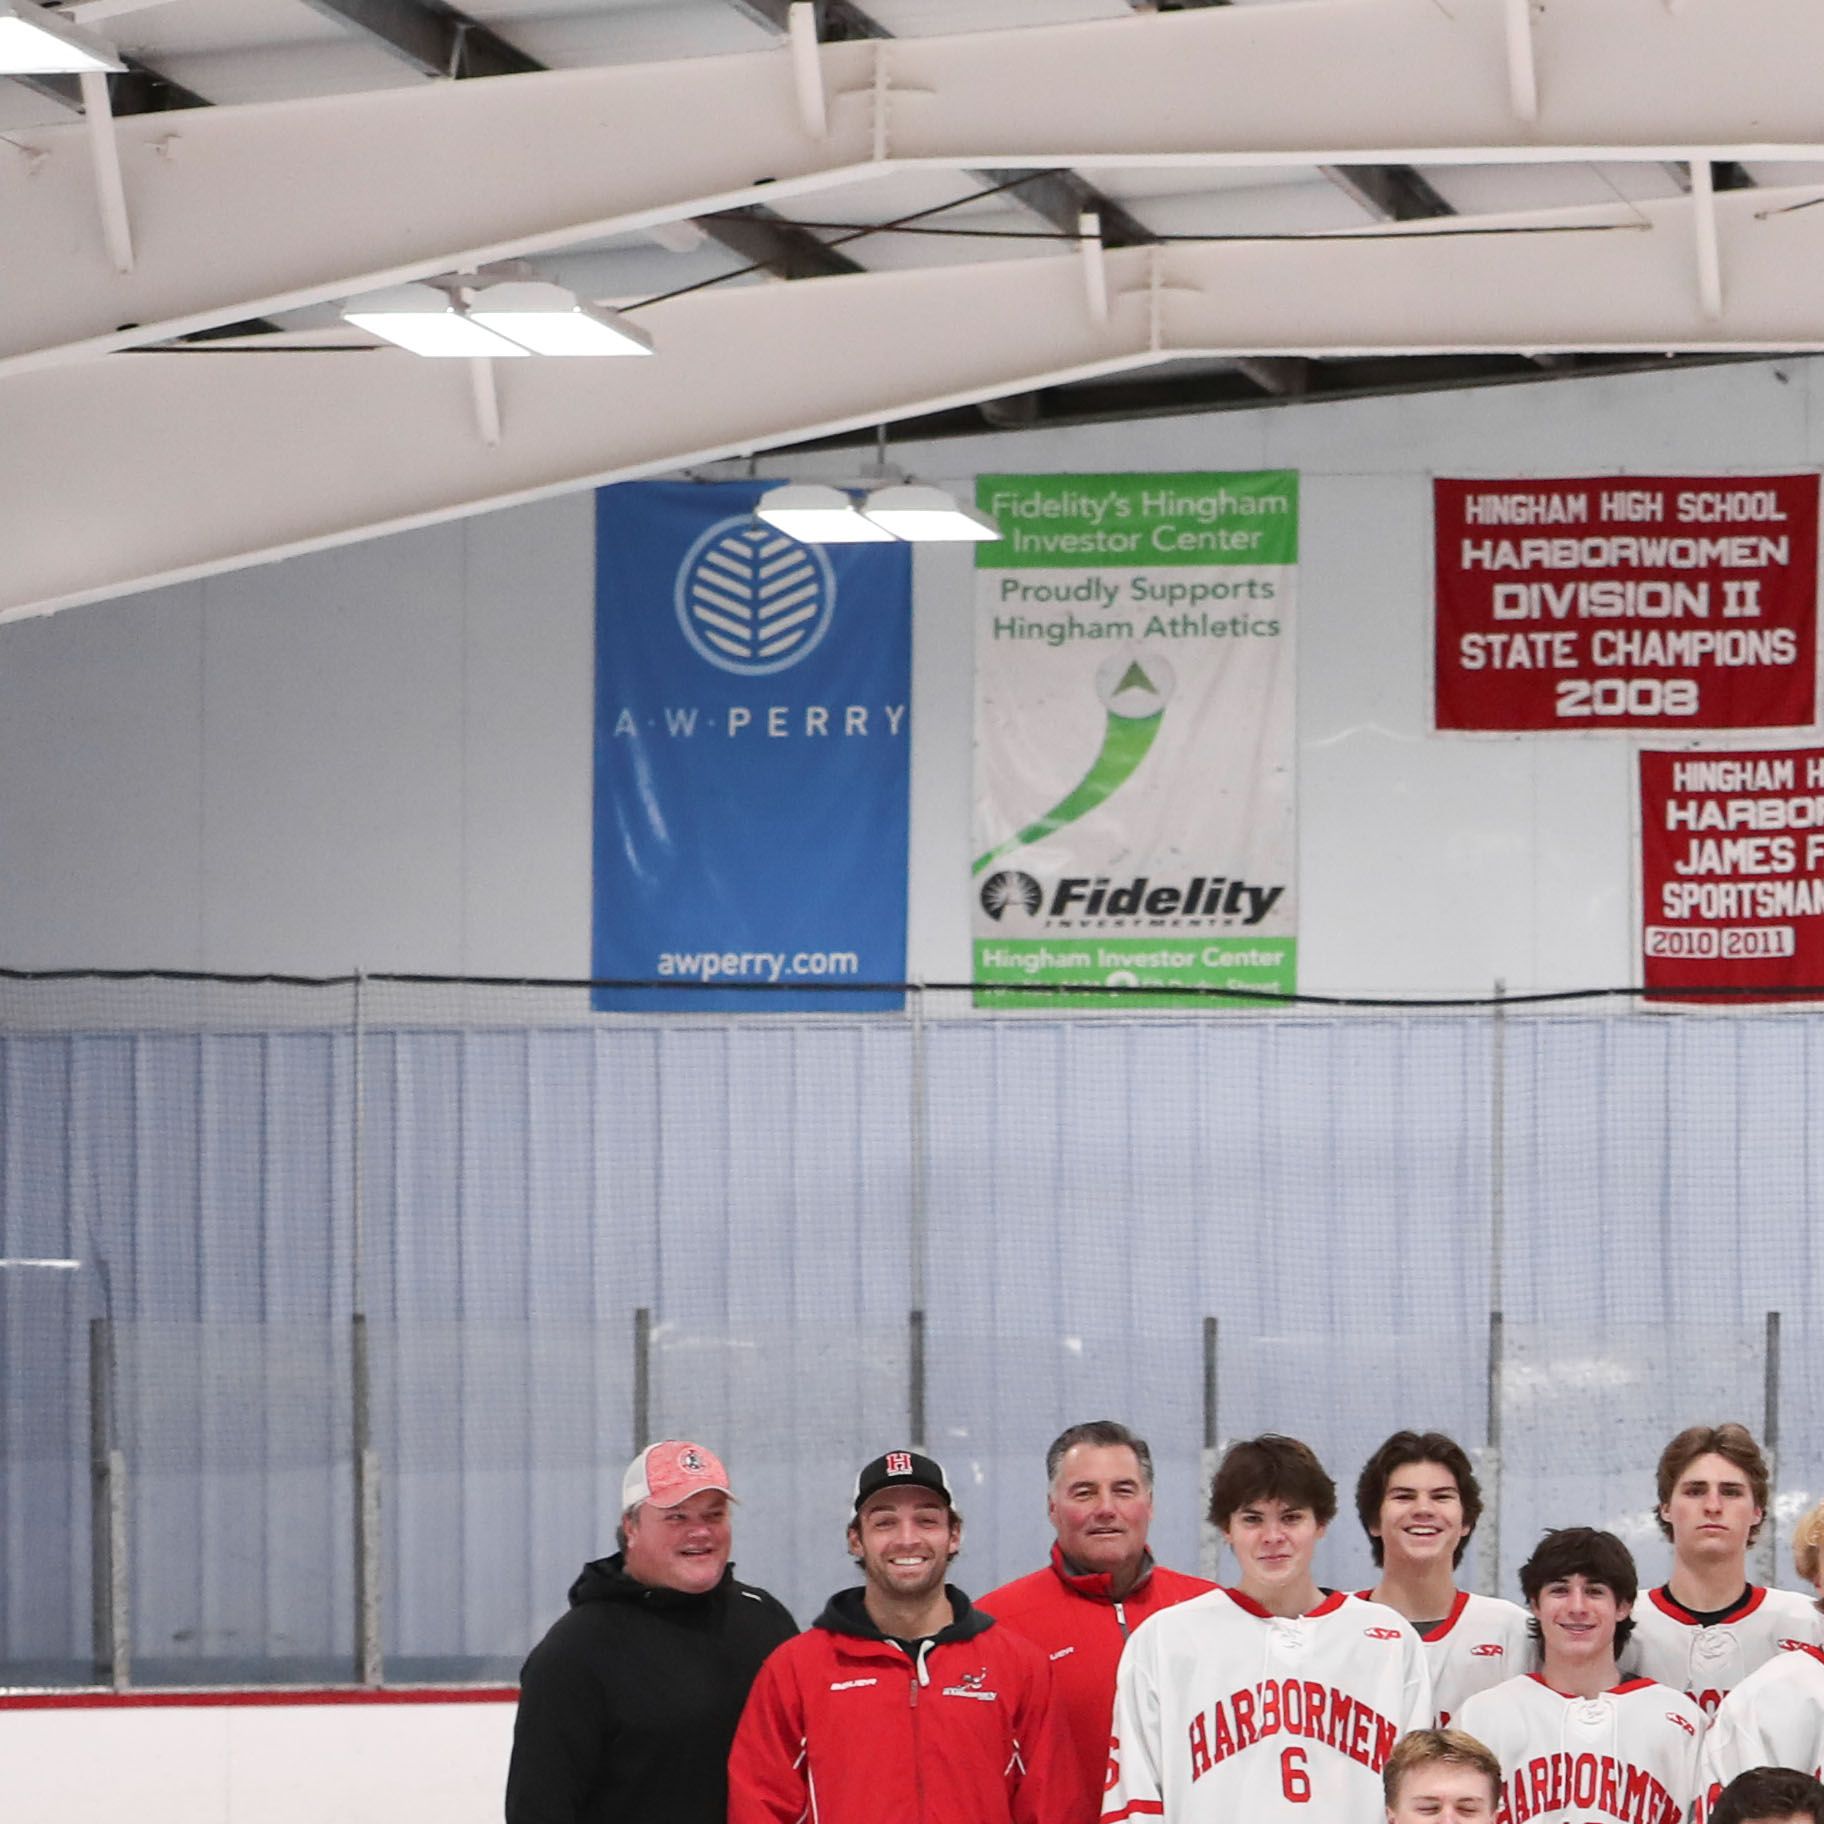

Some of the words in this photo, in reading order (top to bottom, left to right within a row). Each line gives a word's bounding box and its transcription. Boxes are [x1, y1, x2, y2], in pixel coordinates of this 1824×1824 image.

[987, 491, 1132, 529] Fidelity's
[1141, 488, 1288, 524] Hingham
[1466, 494, 1587, 524] HINGHAM
[1601, 491, 1663, 521] HIGH
[1678, 491, 1787, 522] SCHOOL
[1012, 528, 1142, 553] Investor
[1151, 524, 1264, 552] Center
[1462, 536, 1788, 570] HARBORWOMEN
[1000, 576, 1120, 609] Proudly
[1130, 576, 1275, 607] Supports
[1493, 581, 1709, 619] DIVISION
[1723, 581, 1760, 617] II
[993, 613, 1133, 647] Hingham
[1144, 612, 1281, 638] Athletics
[1461, 631, 1578, 669] STATE
[1592, 628, 1796, 666] CHAMPIONS
[1557, 679, 1698, 716] 2008
[1674, 760, 1794, 792] HINGHAM
[1675, 836, 1795, 875] JAMES
[1050, 877, 1285, 925] Fidelity
[1650, 929, 1714, 956] 2010
[1726, 929, 1790, 956] 2011
[658, 952, 858, 982] awperry.com
[983, 947, 1092, 974] Hingham
[1098, 949, 1197, 968] Investor
[1201, 947, 1285, 967] Center
[886, 1453, 913, 1474] H
[1189, 1679, 1398, 1783] HARBORMEN
[1281, 1747, 1311, 1802] 6
